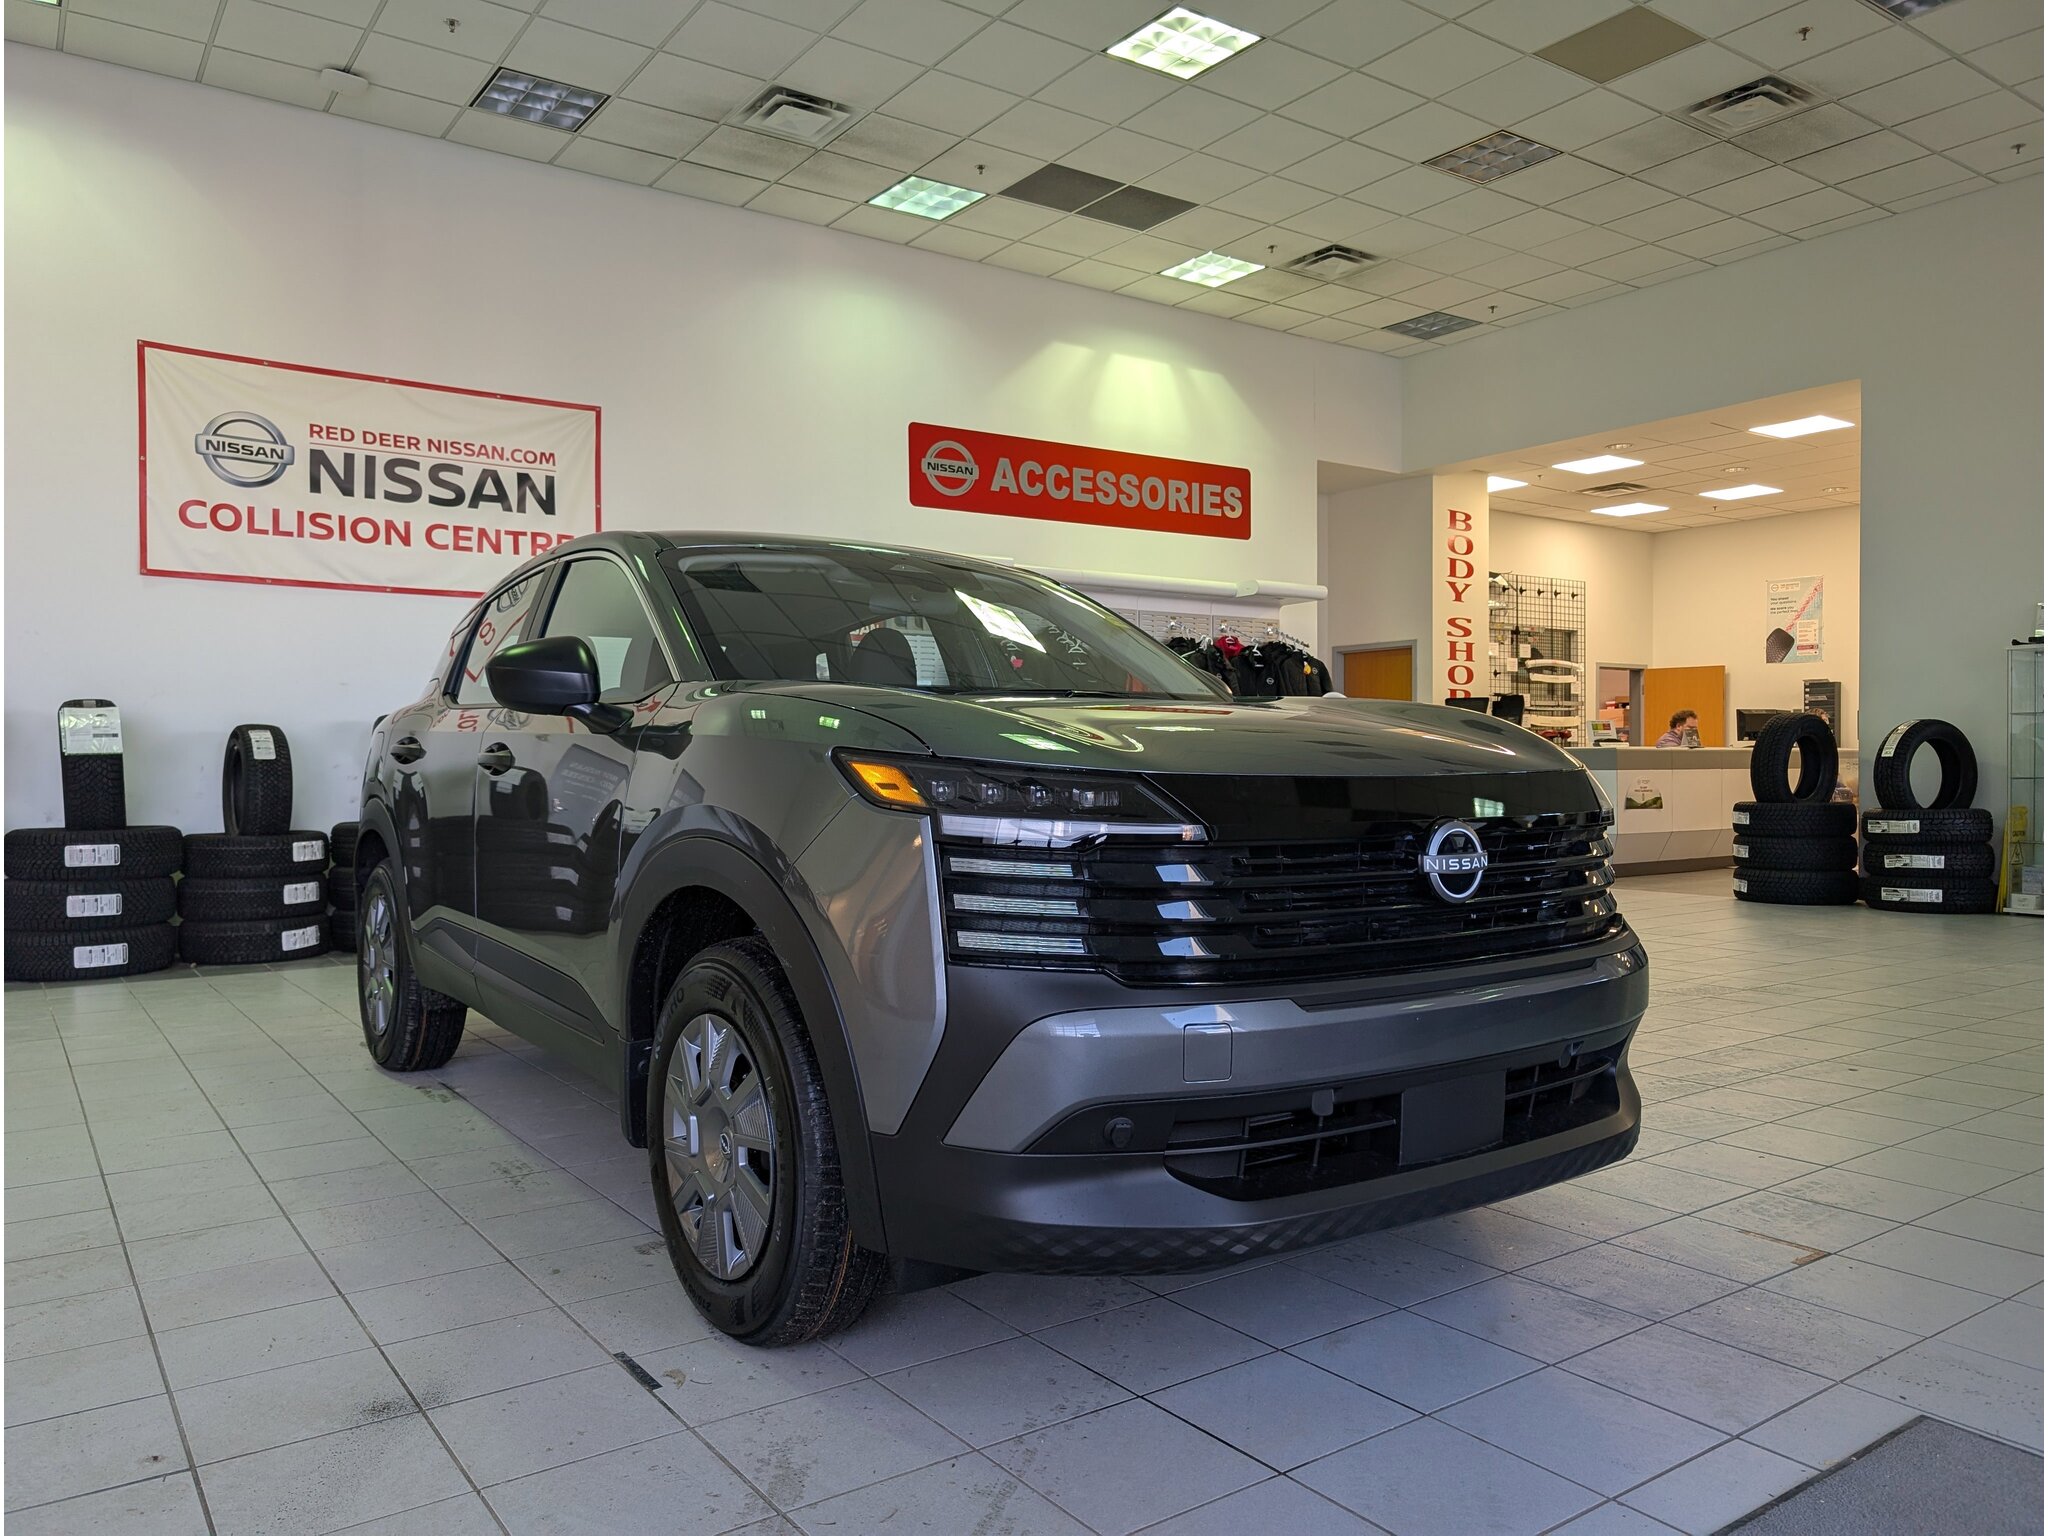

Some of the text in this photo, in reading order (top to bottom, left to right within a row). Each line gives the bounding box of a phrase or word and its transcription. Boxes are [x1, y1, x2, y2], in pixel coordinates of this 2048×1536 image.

[204, 438, 285, 461] NISSAN
[309, 423, 556, 467] RED DEER NISSAN.COM
[309, 448, 556, 516] NISSAN
[926, 460, 974, 477] NISSAN
[990, 457, 1243, 520] ACCESSORIES
[178, 499, 412, 547] COLLISION
[1446, 508, 1475, 603] BODY
[1426, 855, 1488, 870] NISSAN
